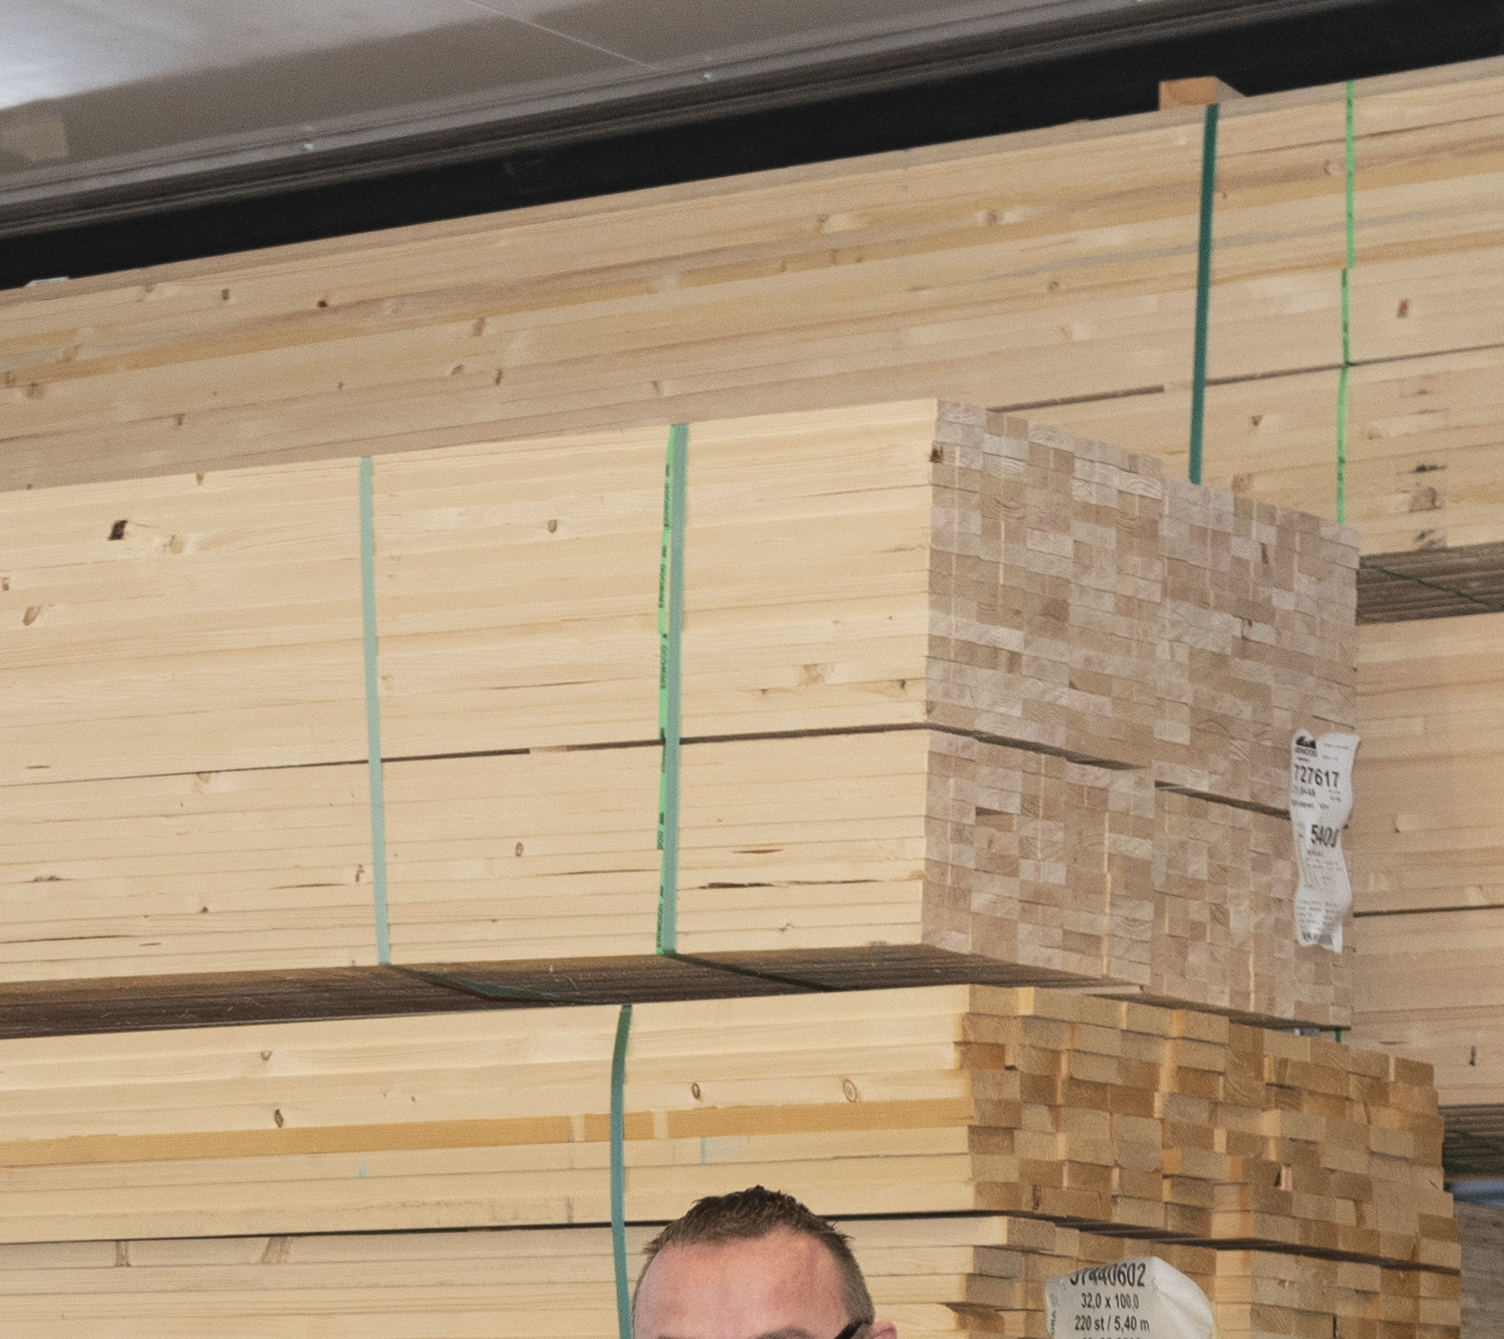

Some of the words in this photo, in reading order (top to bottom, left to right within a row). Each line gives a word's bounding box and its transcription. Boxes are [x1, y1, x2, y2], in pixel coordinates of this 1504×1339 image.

[1294, 764, 1340, 789] 727617
[1075, 1315, 1092, 1331] 220
[1094, 1316, 1105, 1331] st
[1114, 1315, 1138, 1333] 5,40
[1140, 1319, 1150, 1331] m
